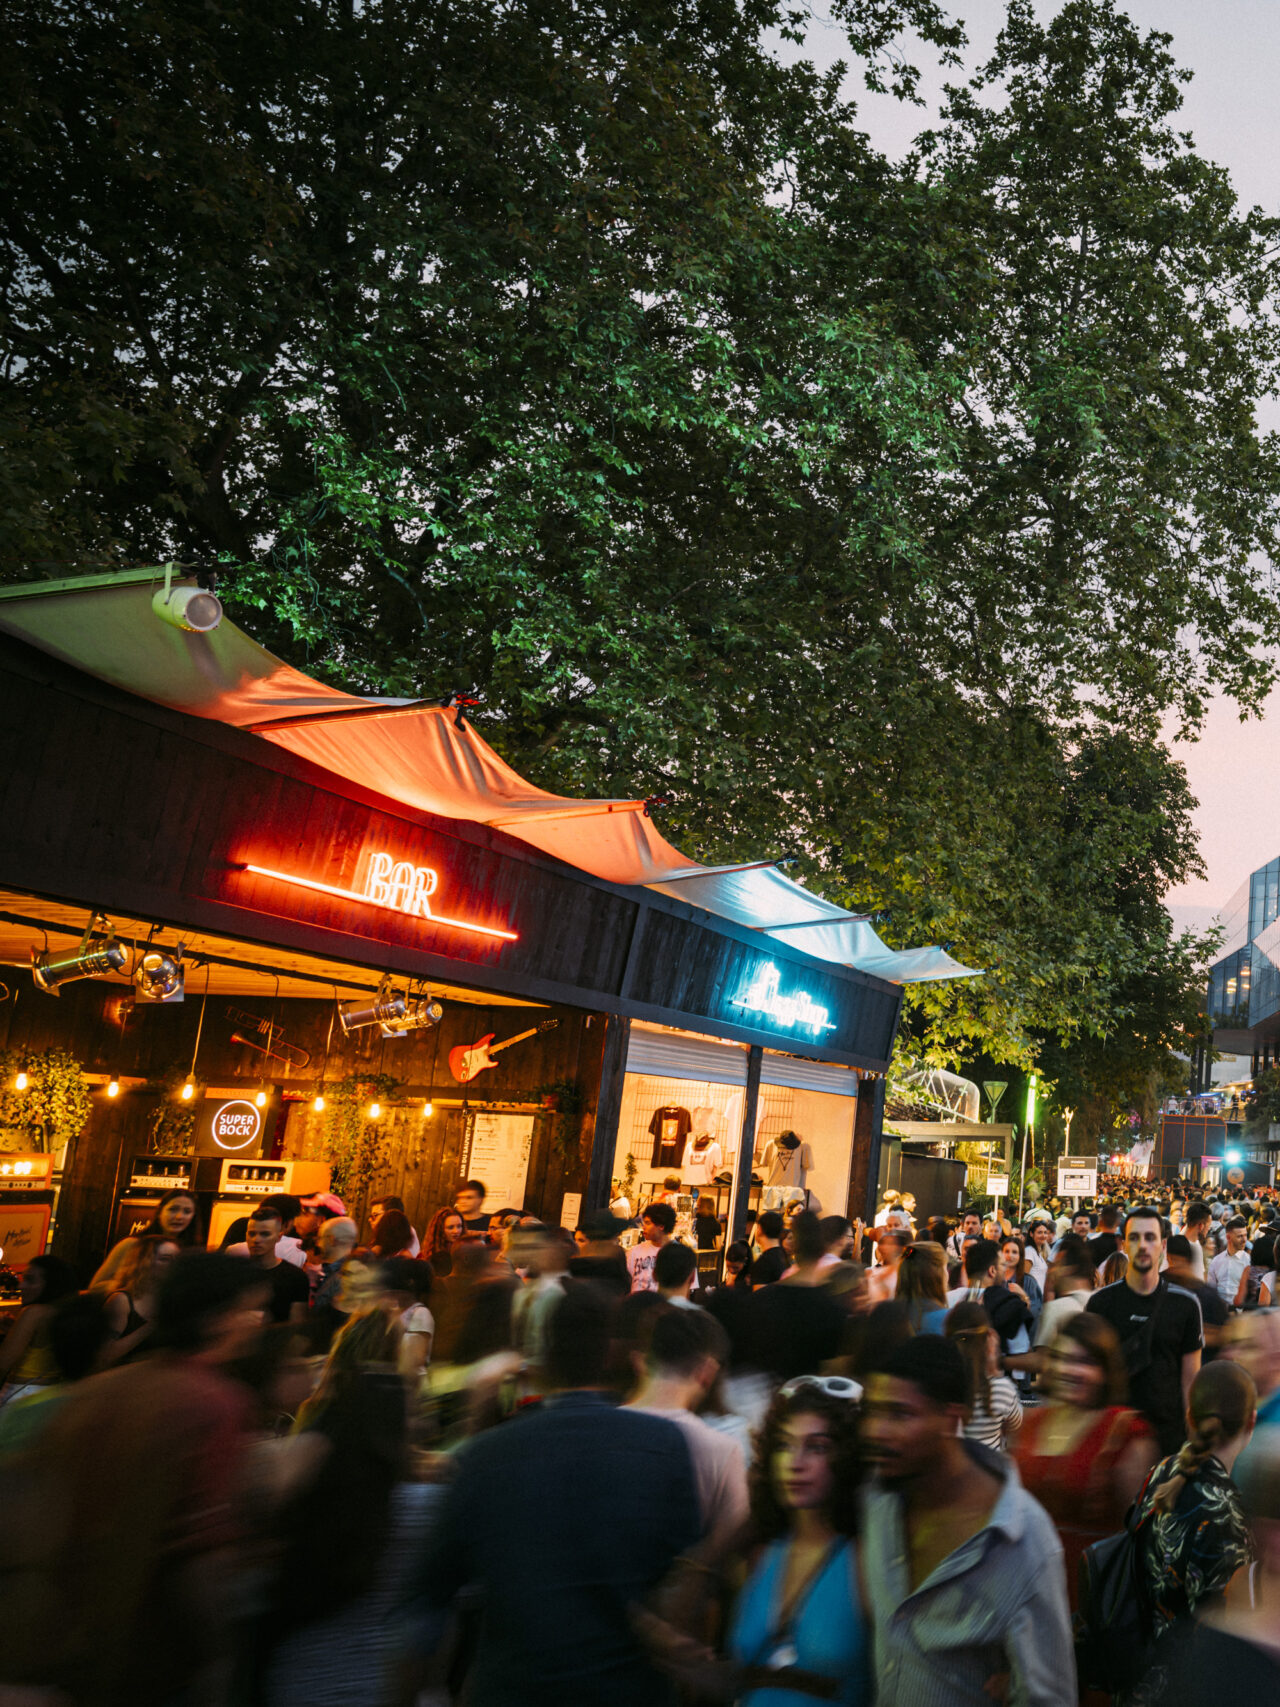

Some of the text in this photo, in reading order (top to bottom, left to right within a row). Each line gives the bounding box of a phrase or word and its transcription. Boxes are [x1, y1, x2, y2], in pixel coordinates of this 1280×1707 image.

[364, 852, 438, 919] BAR
[219, 1113, 254, 1125] SUPER
[219, 1125, 250, 1136] BOCK
